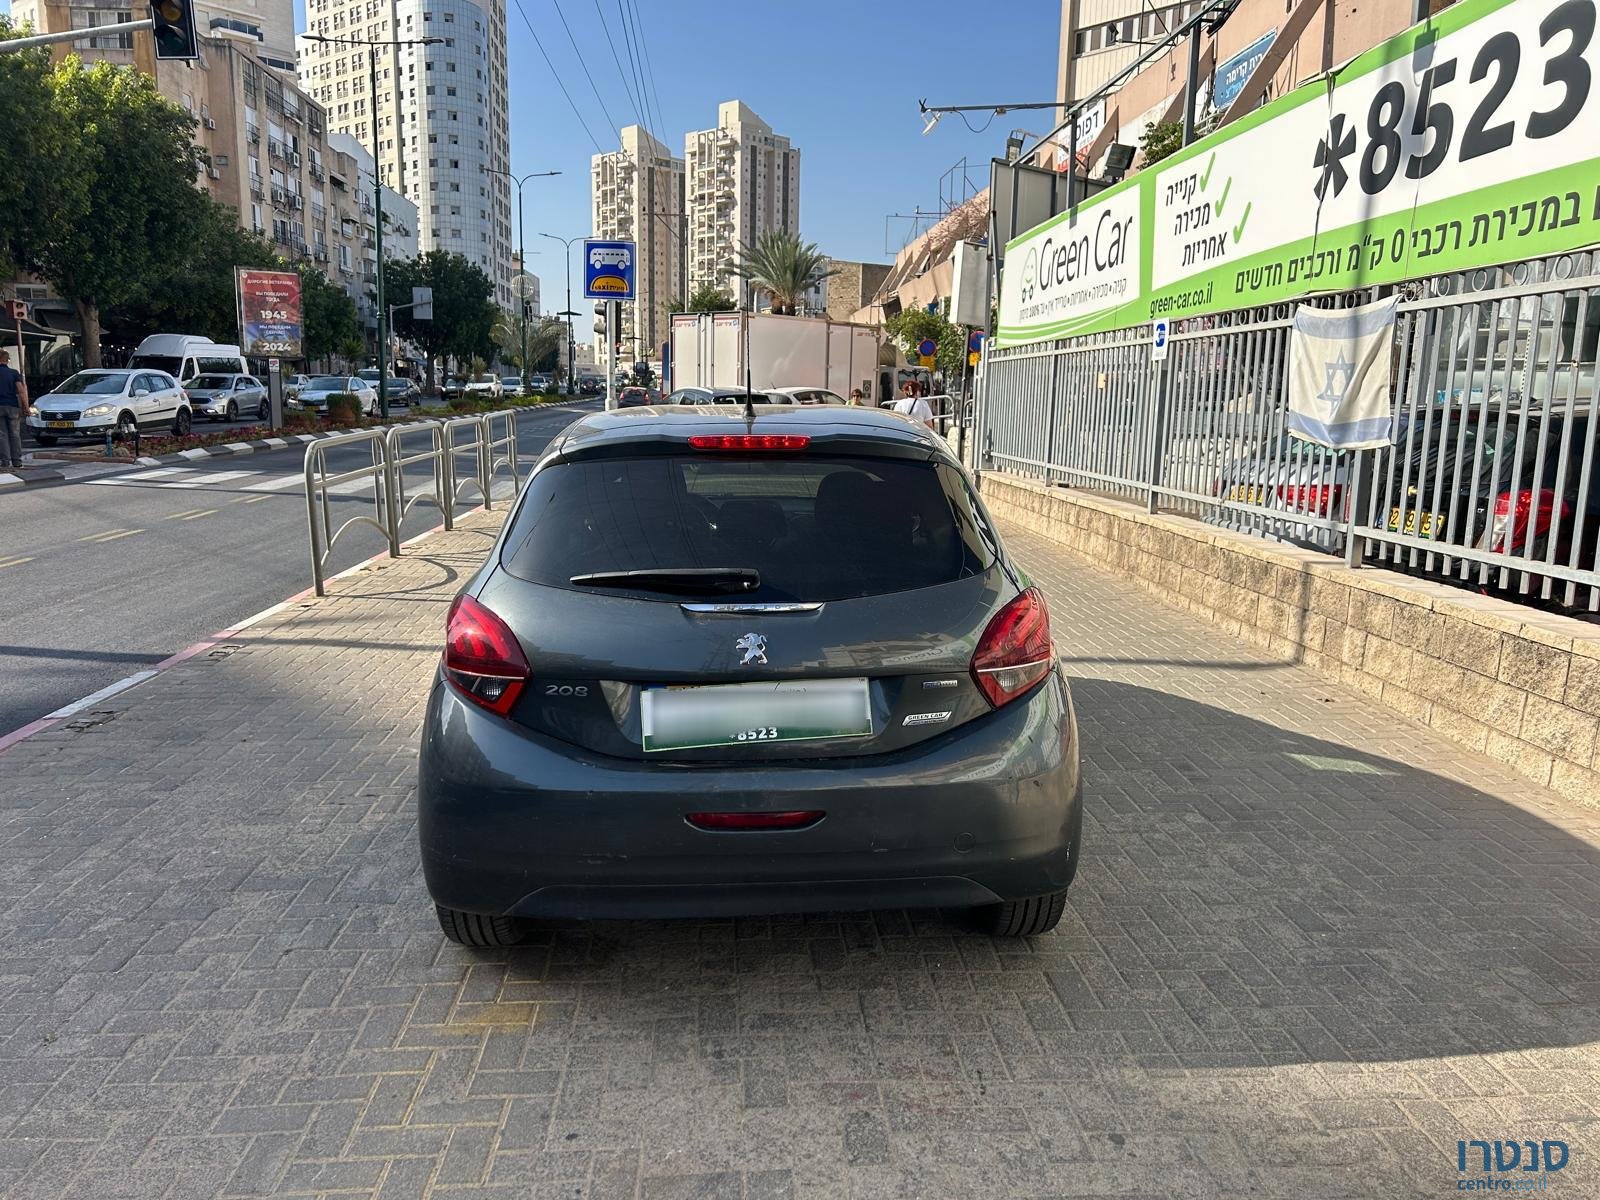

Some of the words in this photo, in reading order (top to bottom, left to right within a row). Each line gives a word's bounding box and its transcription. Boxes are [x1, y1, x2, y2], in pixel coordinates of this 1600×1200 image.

[1165, 173, 1198, 207] קנייה
[1174, 202, 1211, 236] מכירה
[1468, 191, 1581, 248] במכירת
[1039, 237, 1089, 291] Green
[1094, 209, 1133, 272] Car
[1181, 231, 1228, 267] אחריות
[1391, 227, 1406, 263] 0
[1411, 219, 1462, 260] רכבי
[1234, 261, 1284, 294] חדשים
[1286, 247, 1342, 284] ורכבים
[260, 310, 287, 320] 1945
[1149, 281, 1214, 318] green-car.co.il
[263, 342, 292, 352] 2024
[545, 684, 588, 697] 208
